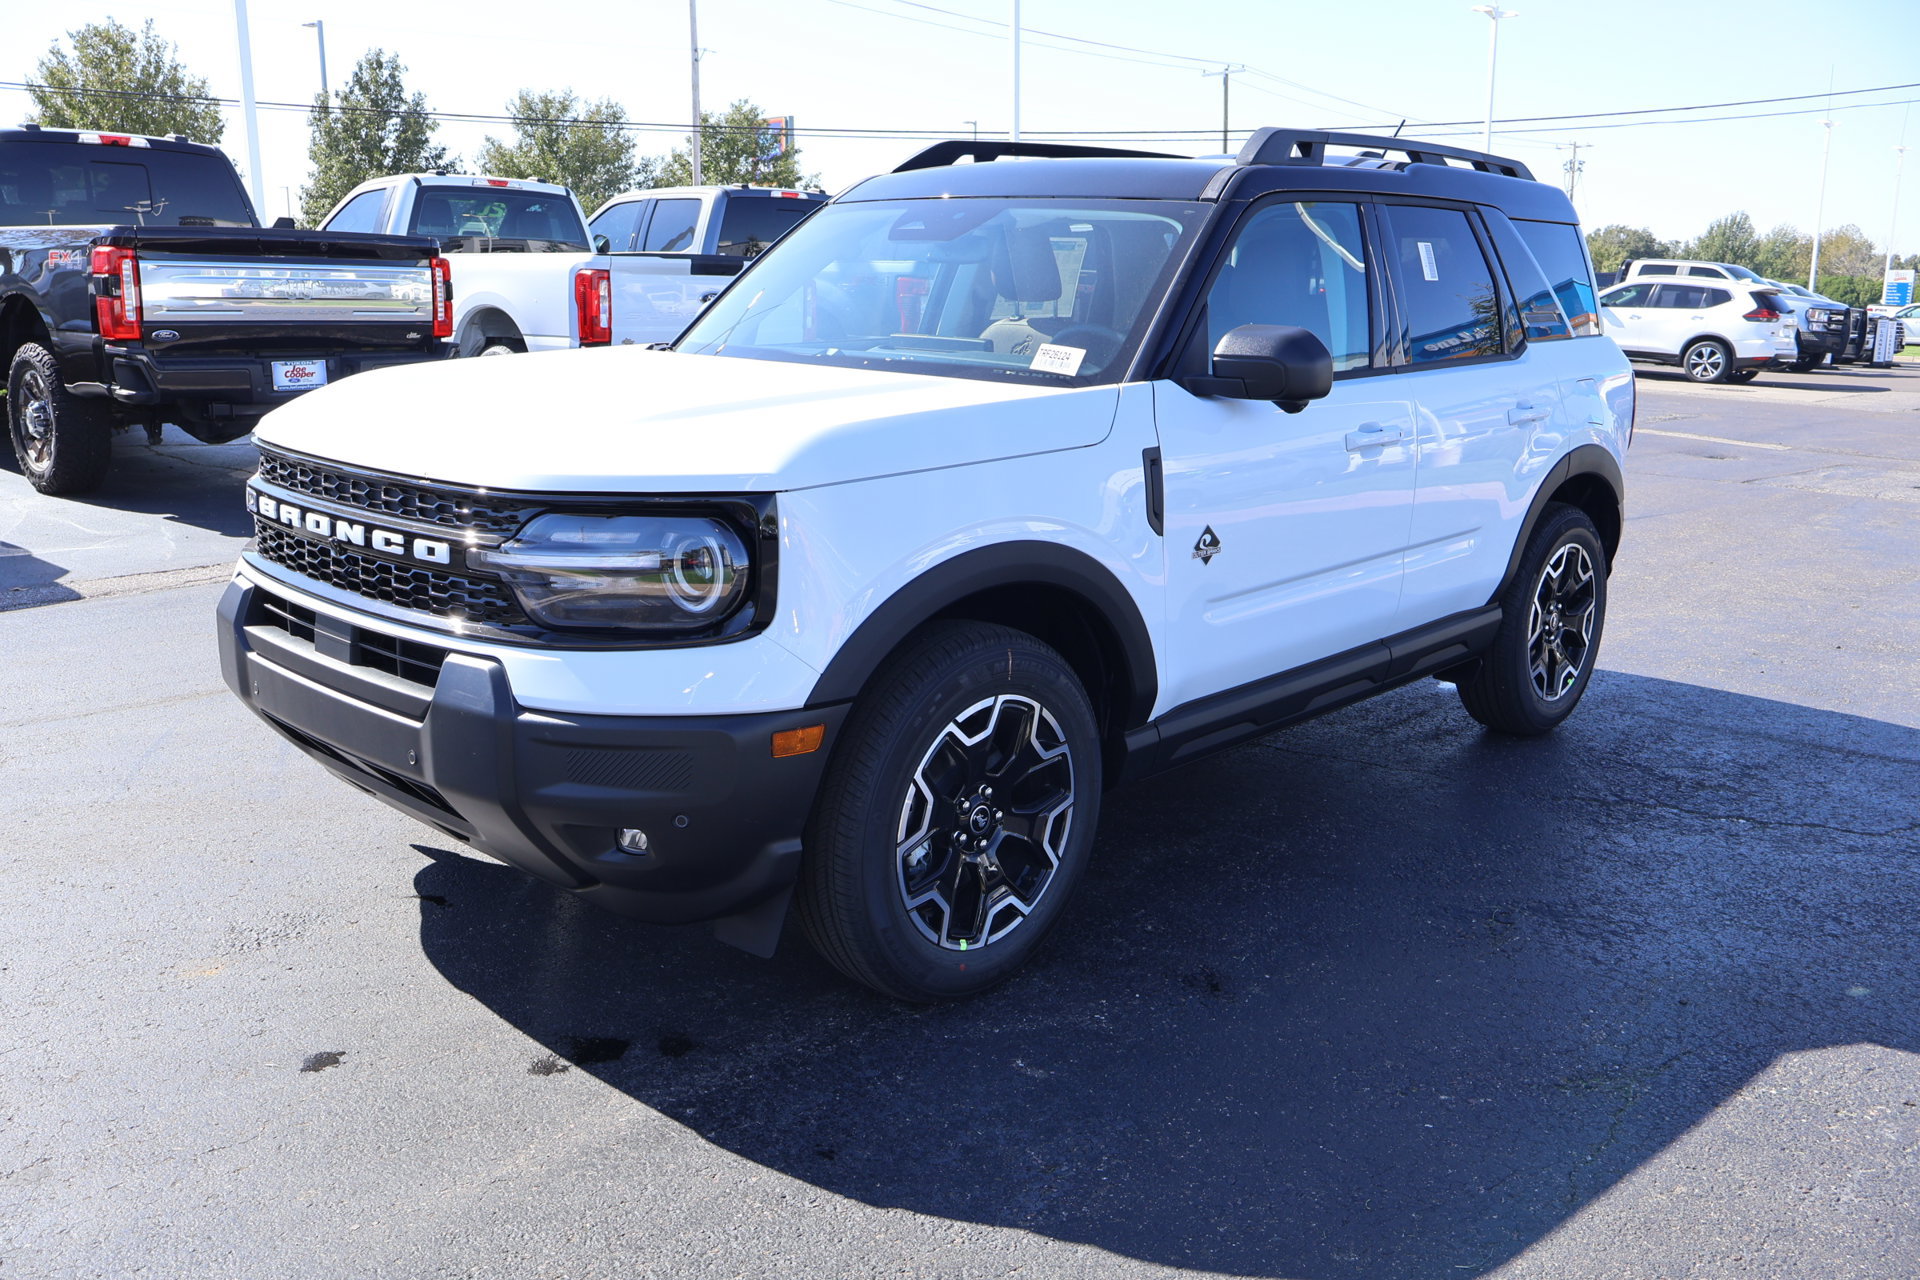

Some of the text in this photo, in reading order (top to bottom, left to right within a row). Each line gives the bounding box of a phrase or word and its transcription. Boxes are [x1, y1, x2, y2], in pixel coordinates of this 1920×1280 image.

[49, 249, 81, 269] FX4
[284, 370, 316, 378] Cooper
[290, 365, 306, 373] Joe
[258, 496, 450, 565] BRONCO
